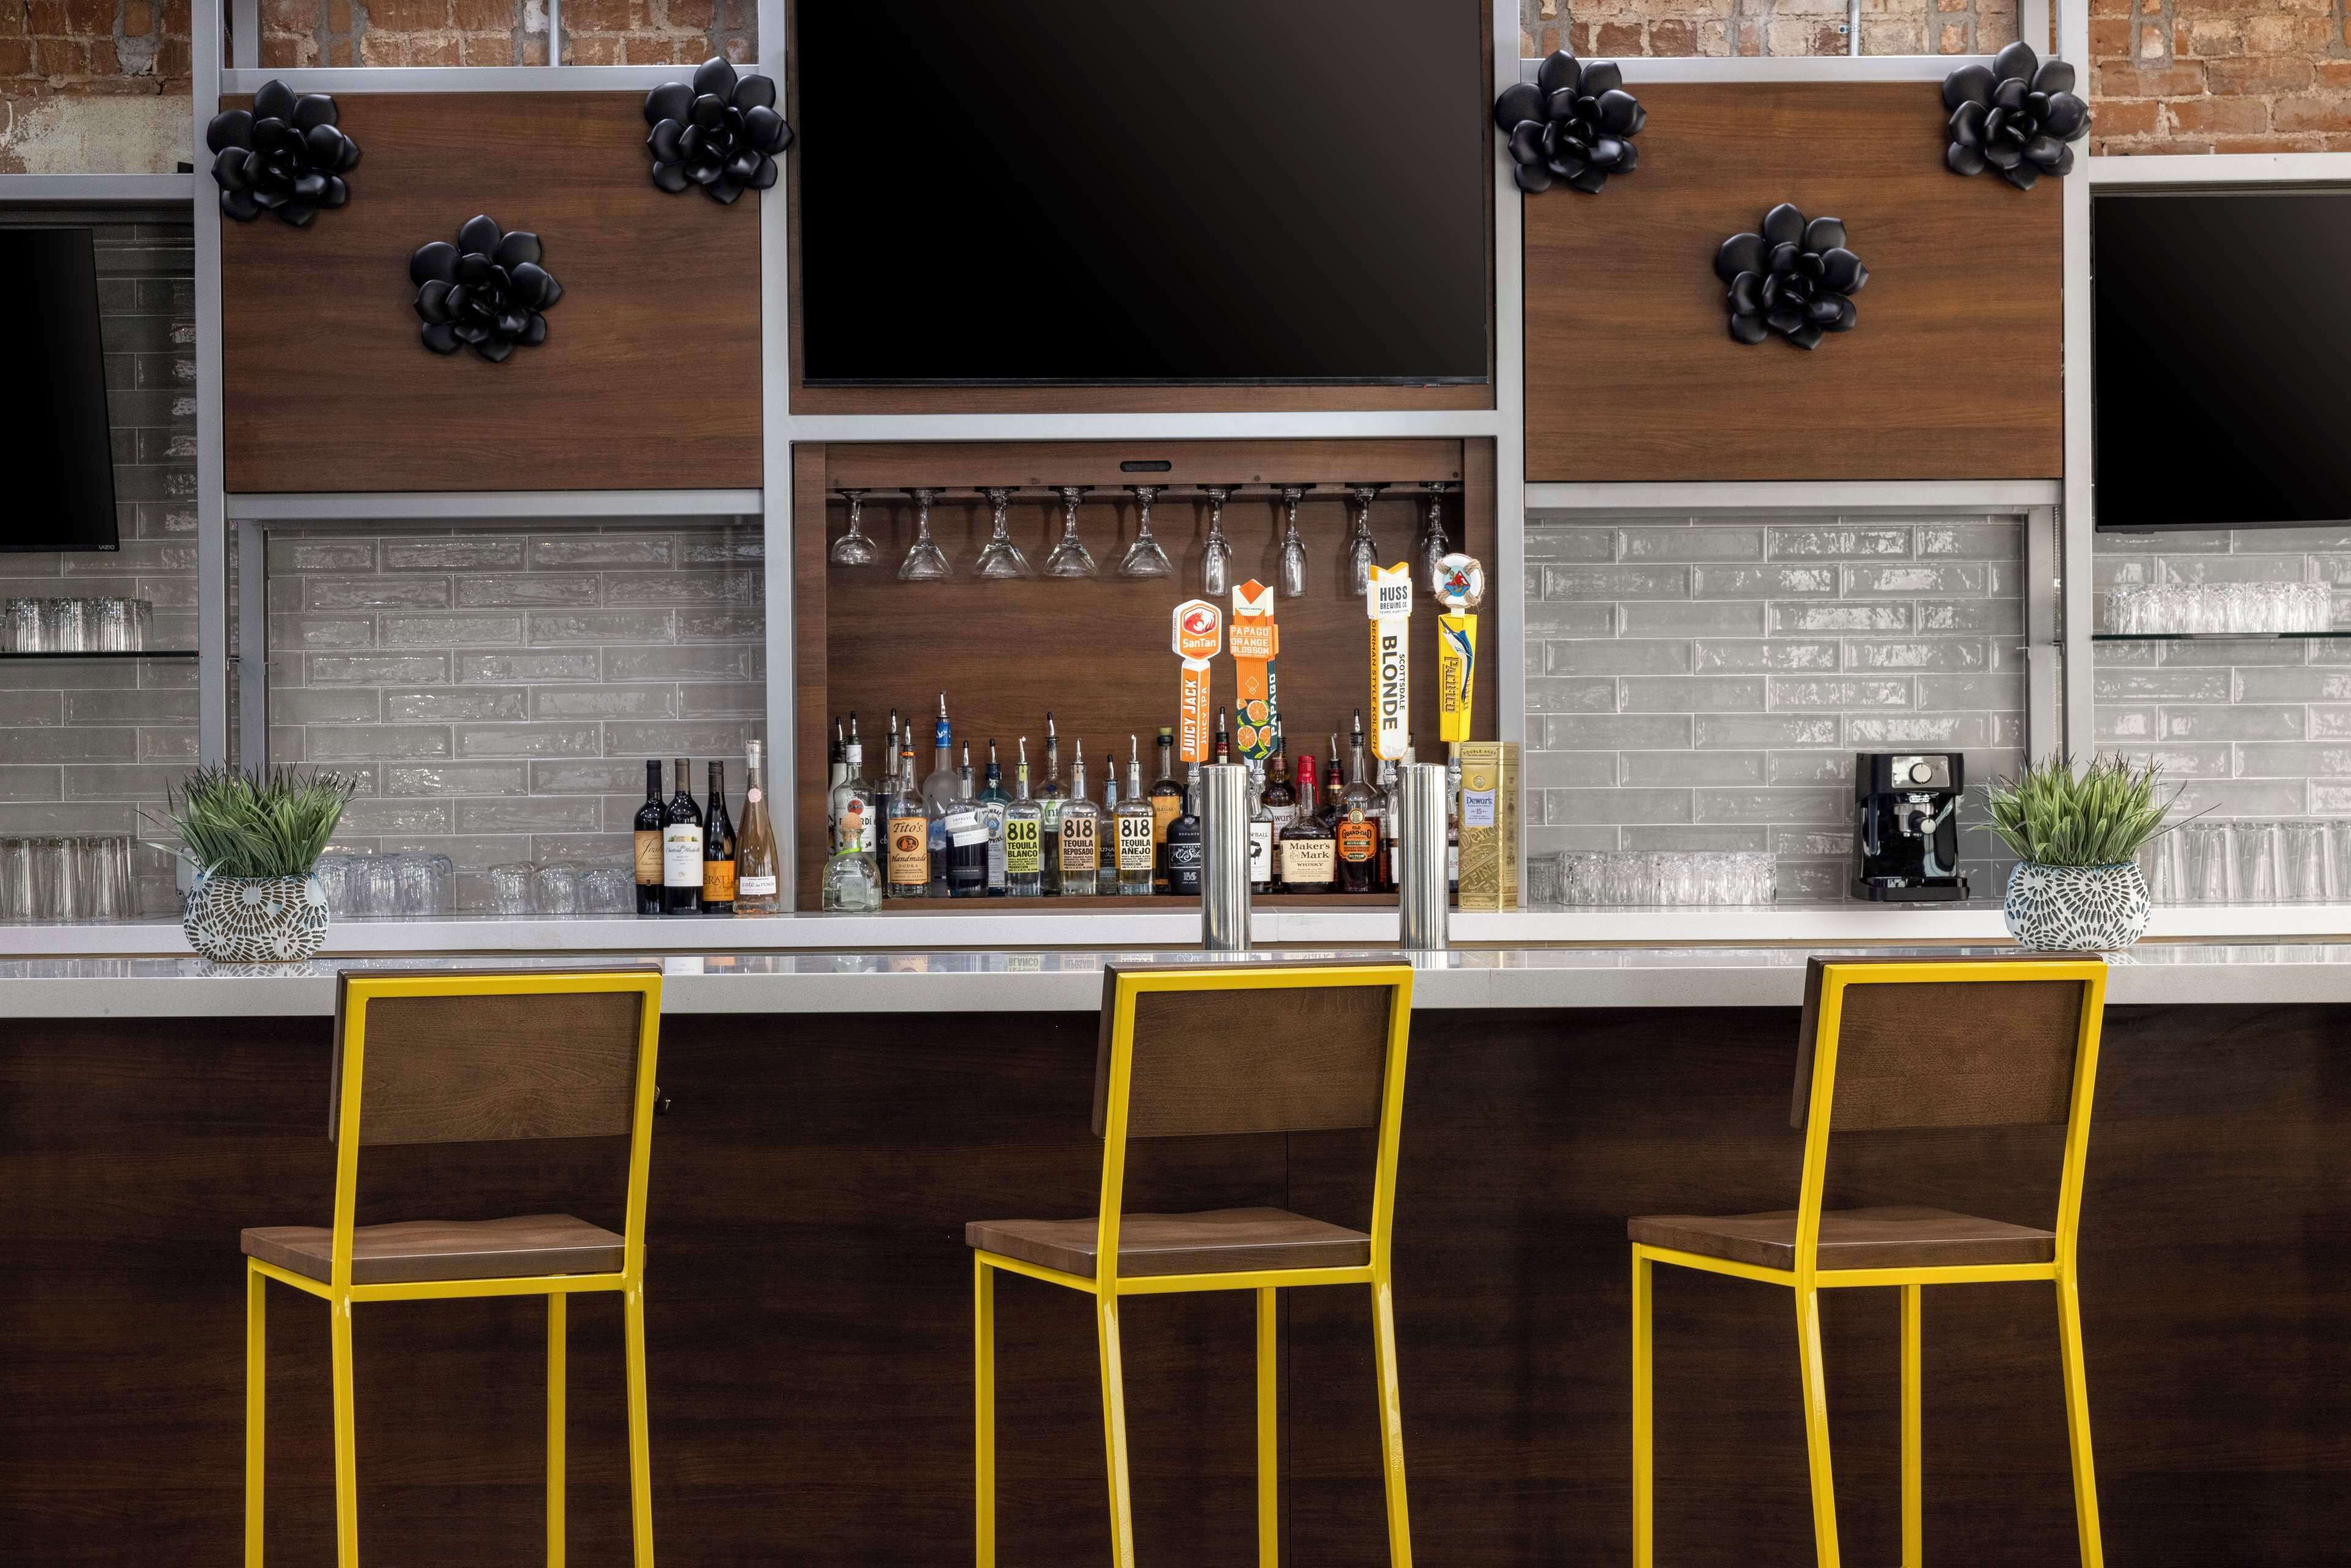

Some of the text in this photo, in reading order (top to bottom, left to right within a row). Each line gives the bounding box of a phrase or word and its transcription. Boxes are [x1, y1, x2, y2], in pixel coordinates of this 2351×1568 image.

[1380, 585, 1408, 601] HUSS
[1231, 626, 1269, 637] PAPAGO
[1182, 638, 1217, 648] SanTan
[1231, 638, 1269, 647] ORANGE
[1382, 636, 1398, 730] BLONDE
[1444, 656, 1459, 714] PACIFICO
[1269, 673, 1278, 737] PAPAGO
[1182, 679, 1198, 756] JUICY JACK
[893, 822, 921, 833] Tito's
[1007, 822, 1037, 841] 818
[1064, 819, 1093, 838] 818
[1122, 819, 1150, 837] 818
[1342, 829, 1371, 839] GRAND-DAD
[891, 853, 926, 863] Handmade
[1121, 846, 1151, 855] AÑEJO
